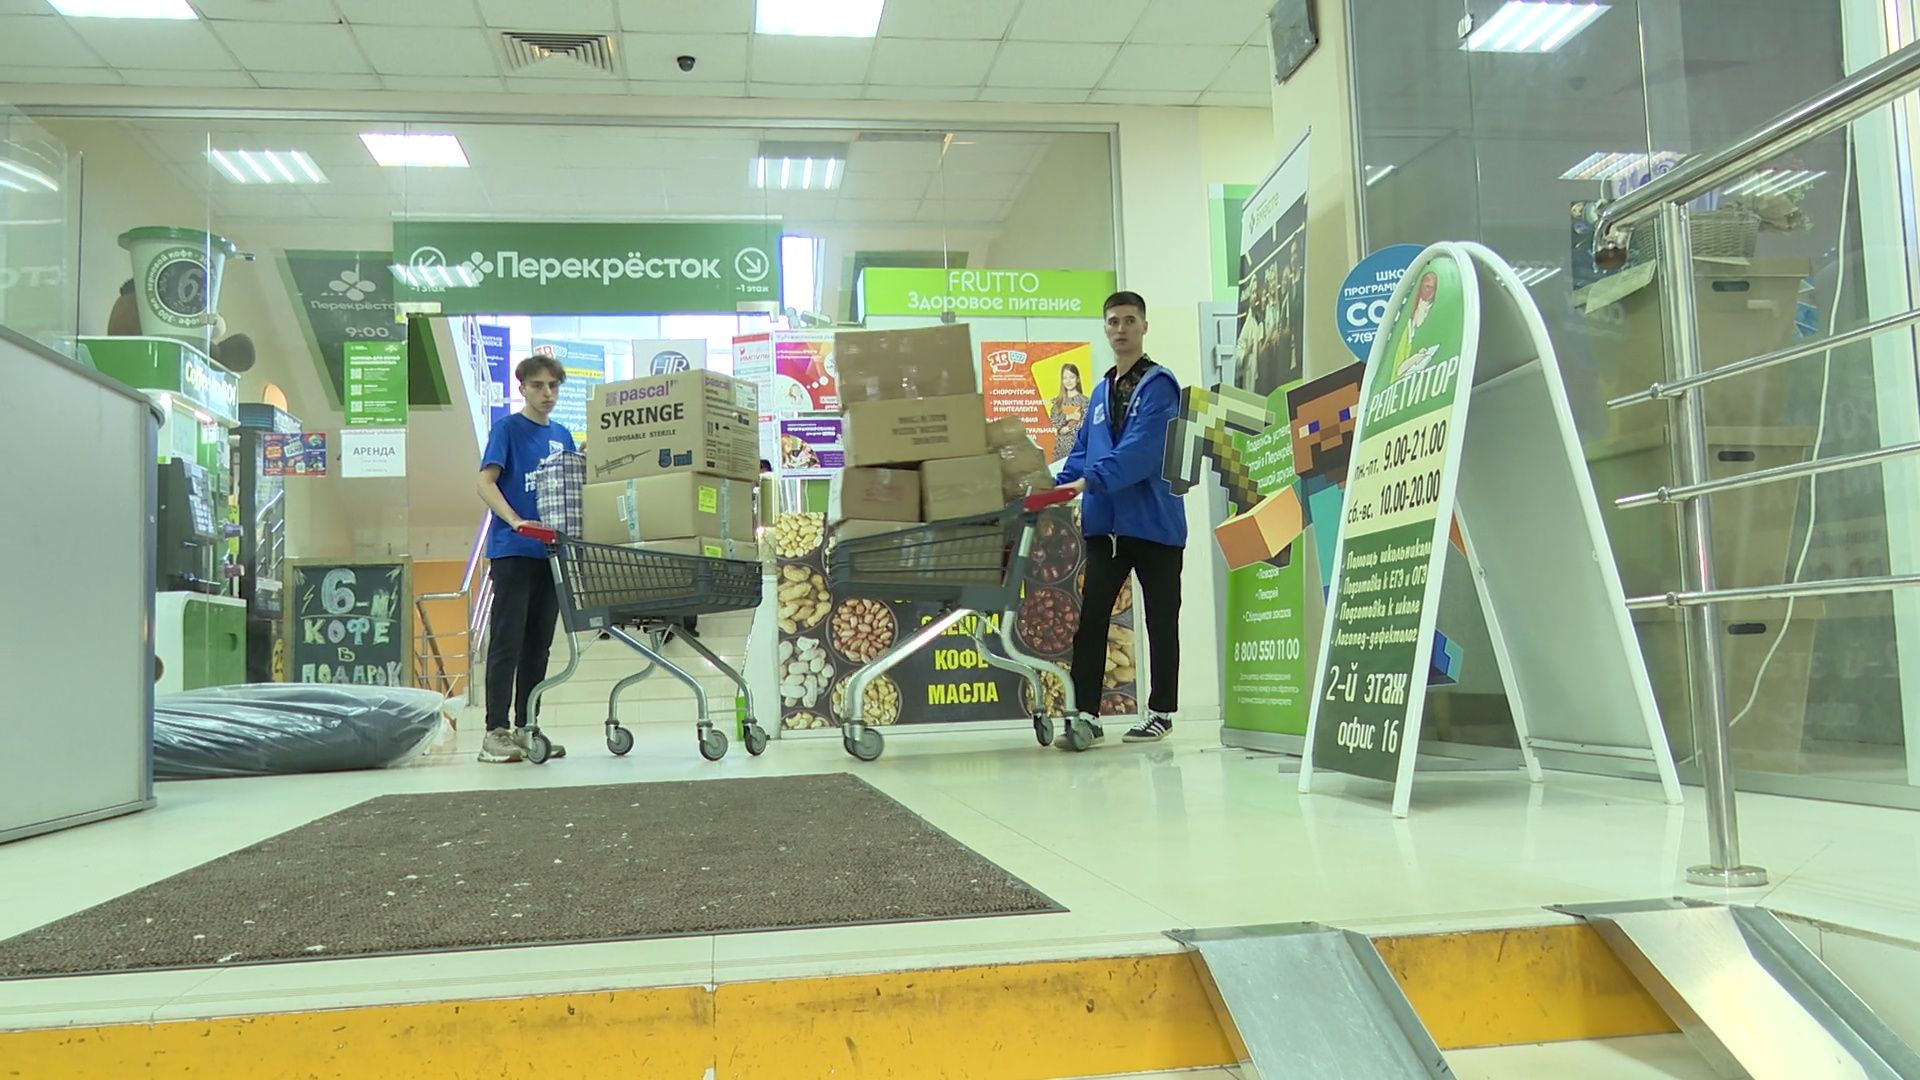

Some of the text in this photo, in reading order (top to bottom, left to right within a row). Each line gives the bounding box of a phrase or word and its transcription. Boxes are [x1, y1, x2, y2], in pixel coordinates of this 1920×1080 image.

[497, 252, 721, 285] Перекрёсток
[1375, 268, 1406, 282] ШКО
[736, 284, 746, 292] -1
[949, 272, 1040, 293] FRUTTO
[310, 300, 395, 311] Перекрёсто
[907, 292, 1081, 312] Здоровое питание
[345, 327, 389, 338] 9:00
[1366, 356, 1460, 427] РЕПЕТИТОР
[600, 403, 684, 430] SYRINGE
[607, 429, 676, 443] DISPOSABLE STERILE
[1384, 421, 1447, 471] 9.00-21.00
[353, 447, 395, 457] АРЕНДА
[658, 448, 672, 468] 5
[673, 450, 693, 467] ml
[1380, 469, 1440, 515] 10.00-20.00
[1346, 538, 1431, 570] Помощь школьникам
[1343, 572, 1382, 599] Подготовка
[1382, 571, 1388, 590] к
[1389, 568, 1404, 589] ЕГЭ
[1411, 564, 1428, 586] ОГЭ
[1339, 595, 1420, 625] Подготовка к школе
[1335, 624, 1417, 651] Логопед-дефектолог
[934, 650, 988, 670] КОФЕ
[1234, 638, 1300, 662] 8 800 550 11 00
[928, 682, 999, 705] МАСЛА
[1326, 662, 1358, 702] 2-й
[1364, 673, 1408, 705] этаж
[1337, 716, 1399, 754] офис 16
